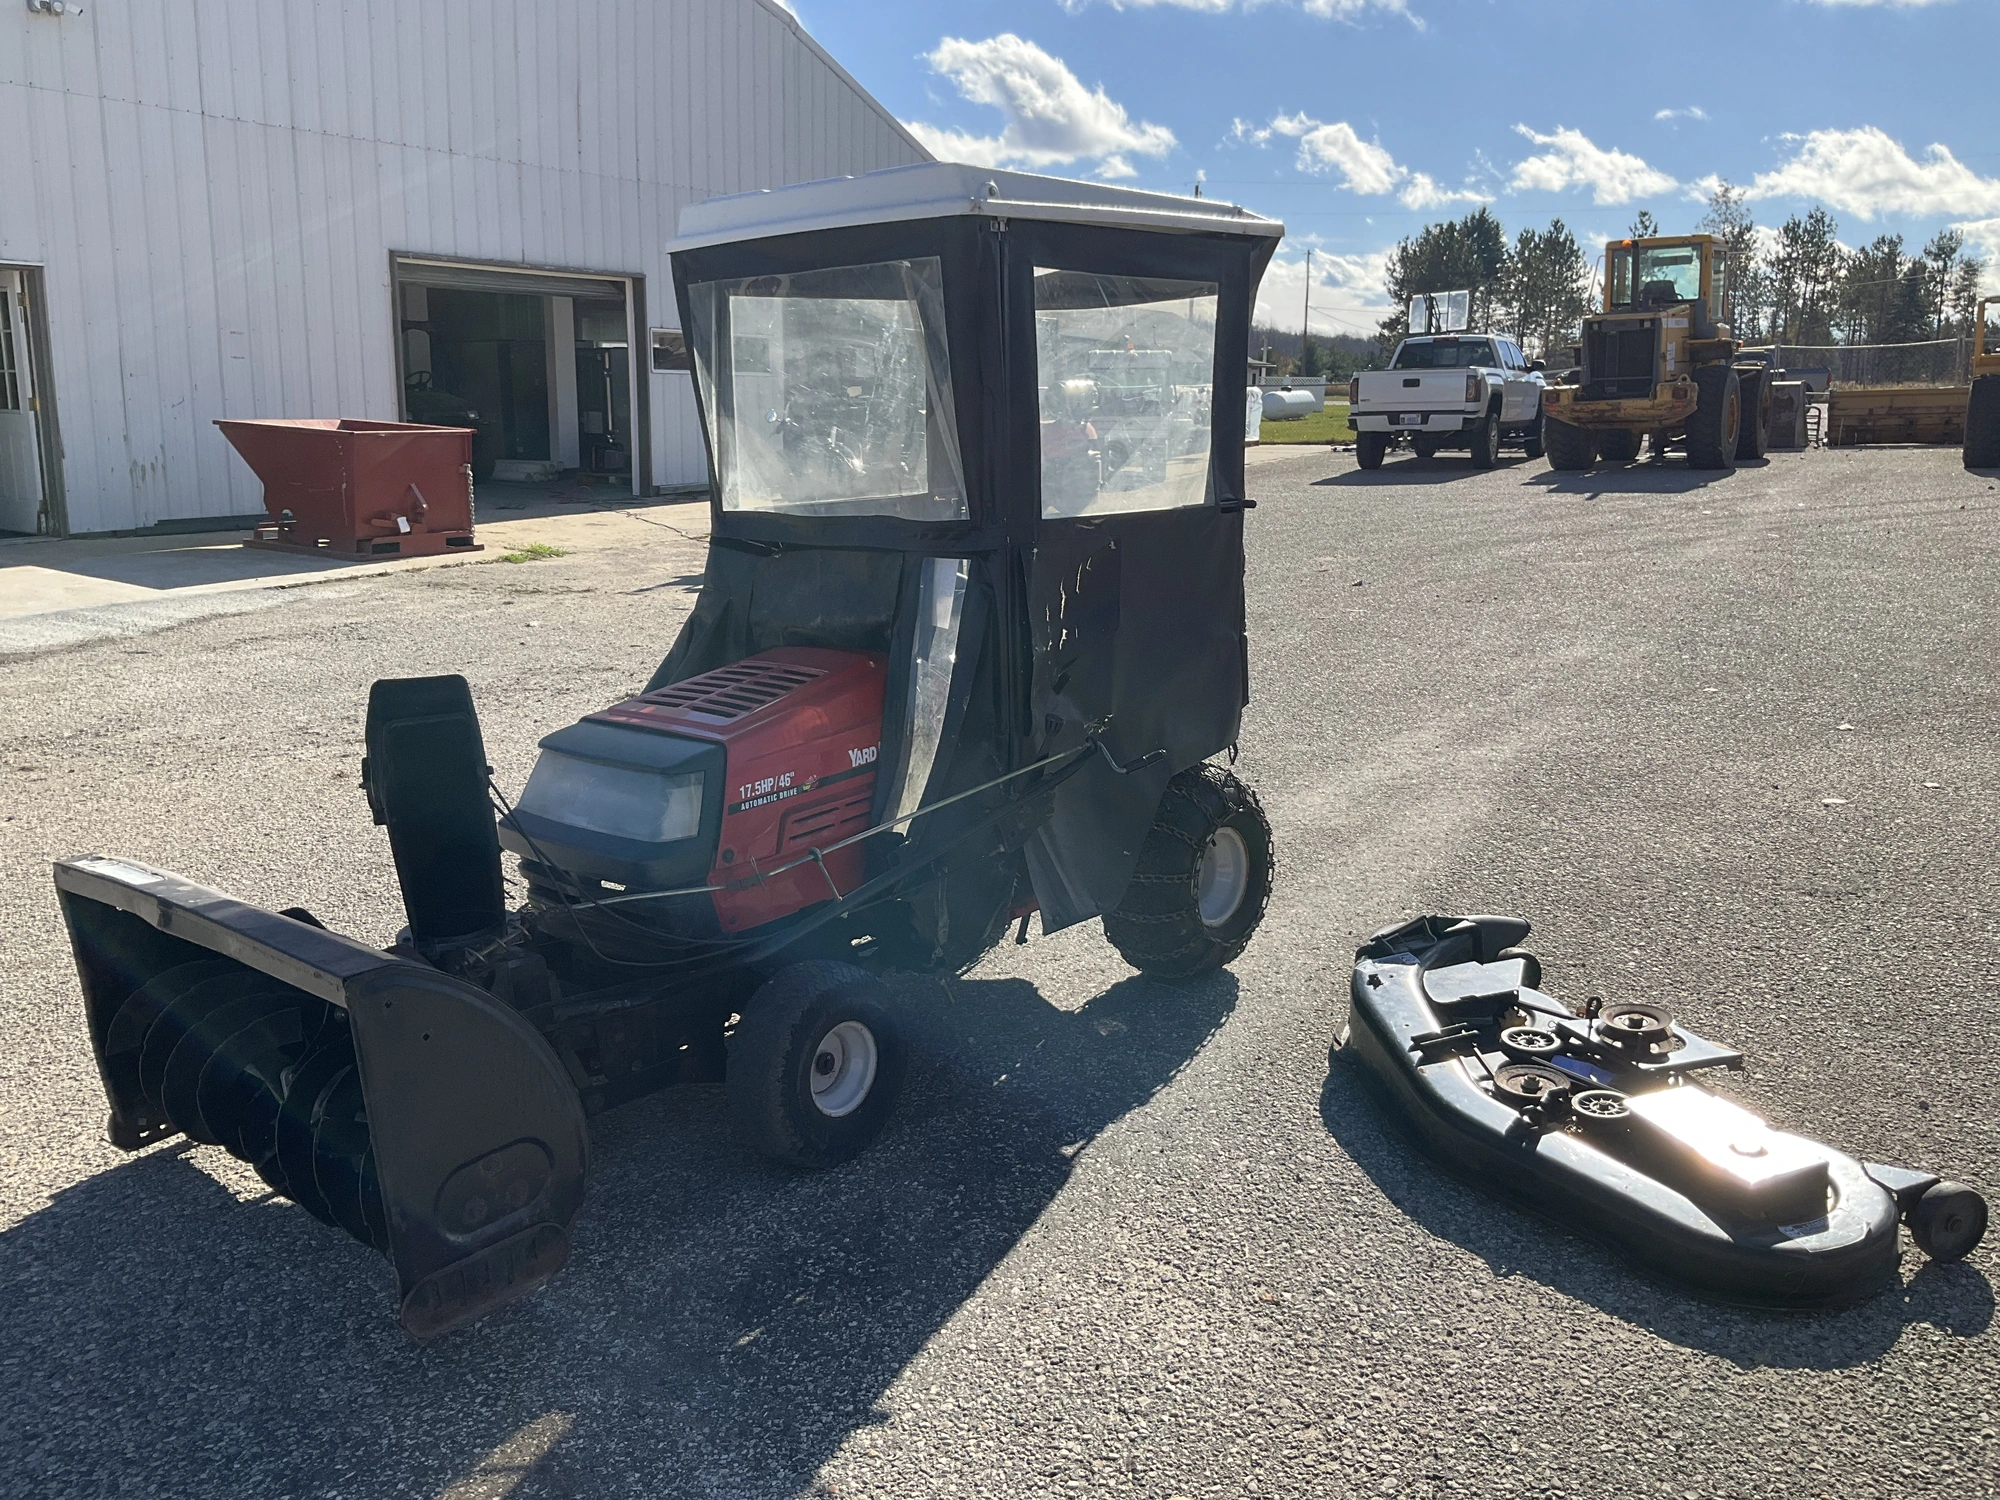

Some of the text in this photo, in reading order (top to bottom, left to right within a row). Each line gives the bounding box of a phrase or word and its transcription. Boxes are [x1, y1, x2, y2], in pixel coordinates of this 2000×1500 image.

[848, 746, 877, 768] YARD
[741, 787, 798, 811] AUTOMATIC DRIVE
